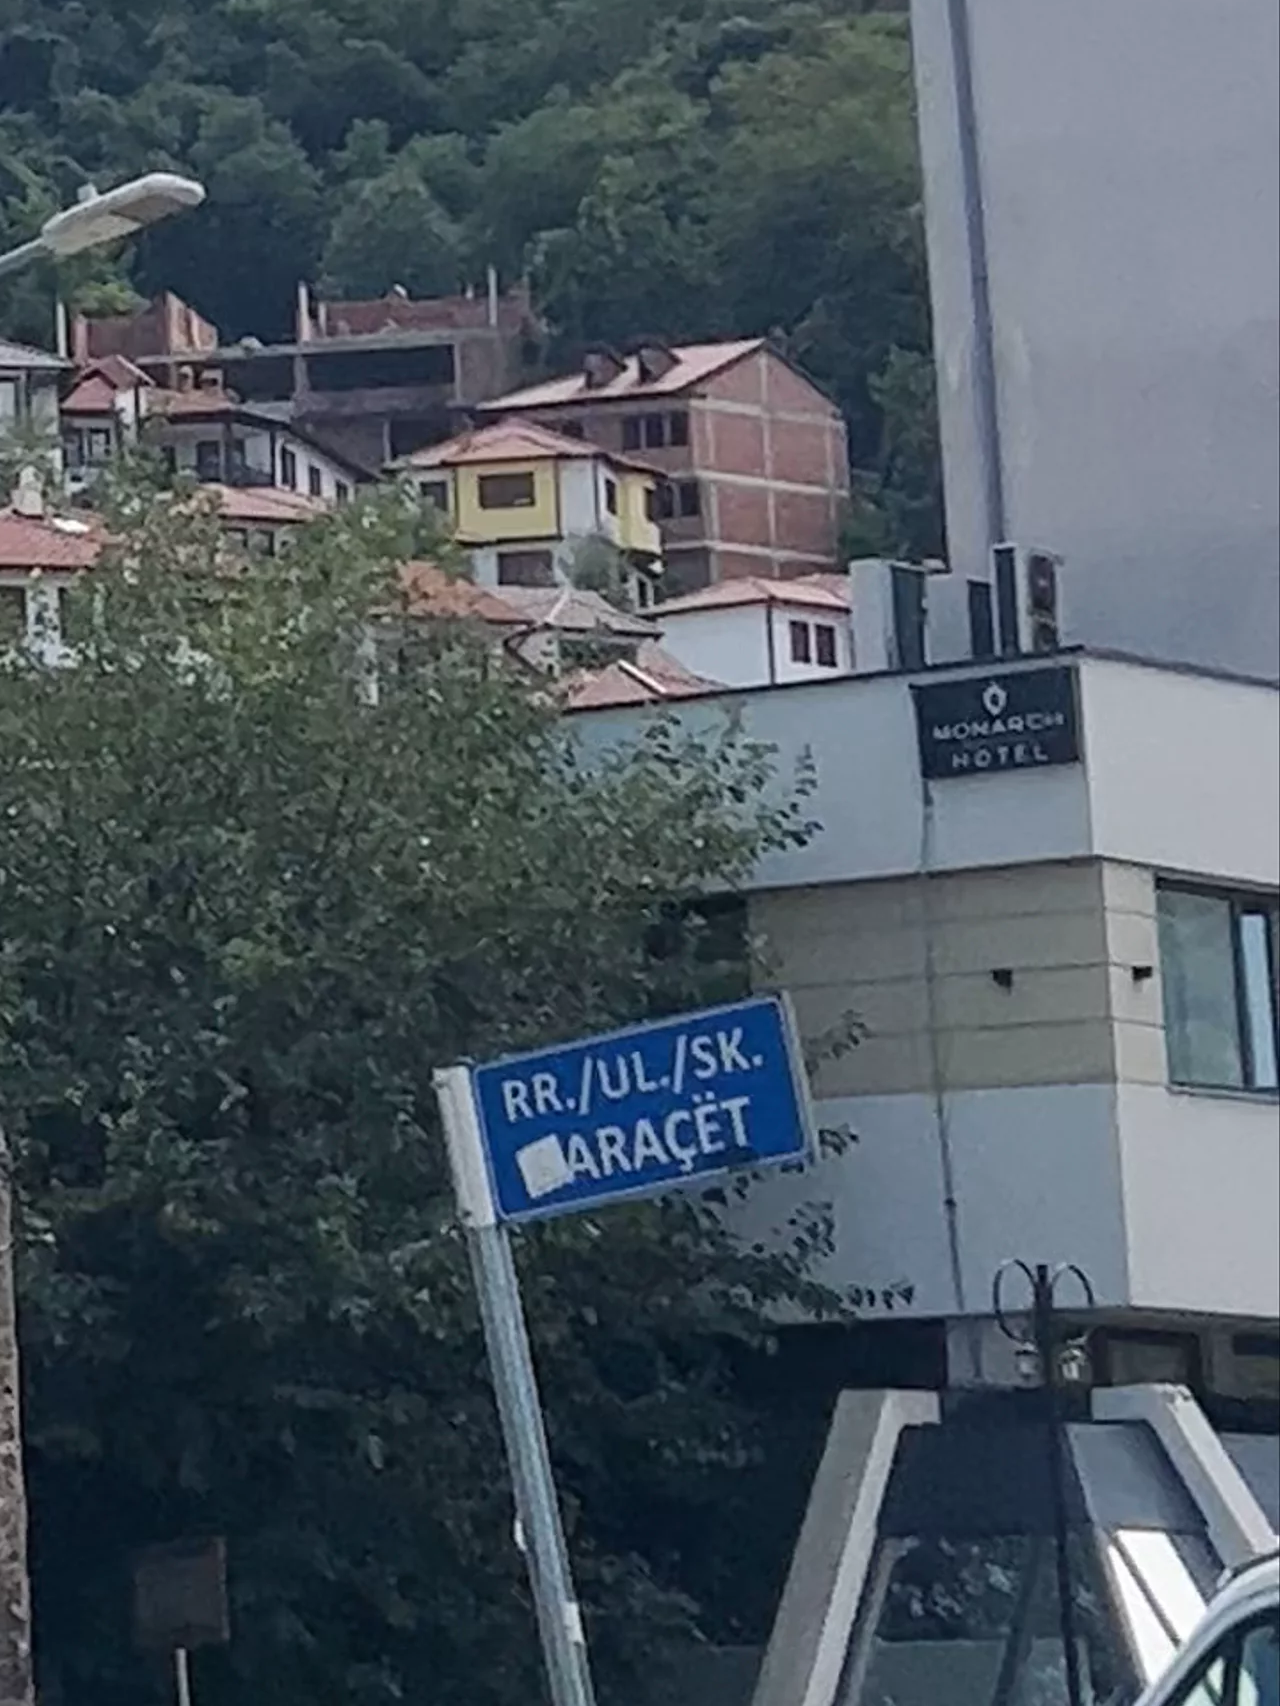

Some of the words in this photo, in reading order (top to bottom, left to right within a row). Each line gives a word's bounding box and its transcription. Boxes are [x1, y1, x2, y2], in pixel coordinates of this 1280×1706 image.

[932, 712, 1064, 740] MONARCH
[951, 743, 1048, 769] HOTEL
[522, 1091, 751, 1192] ARAÇËT
